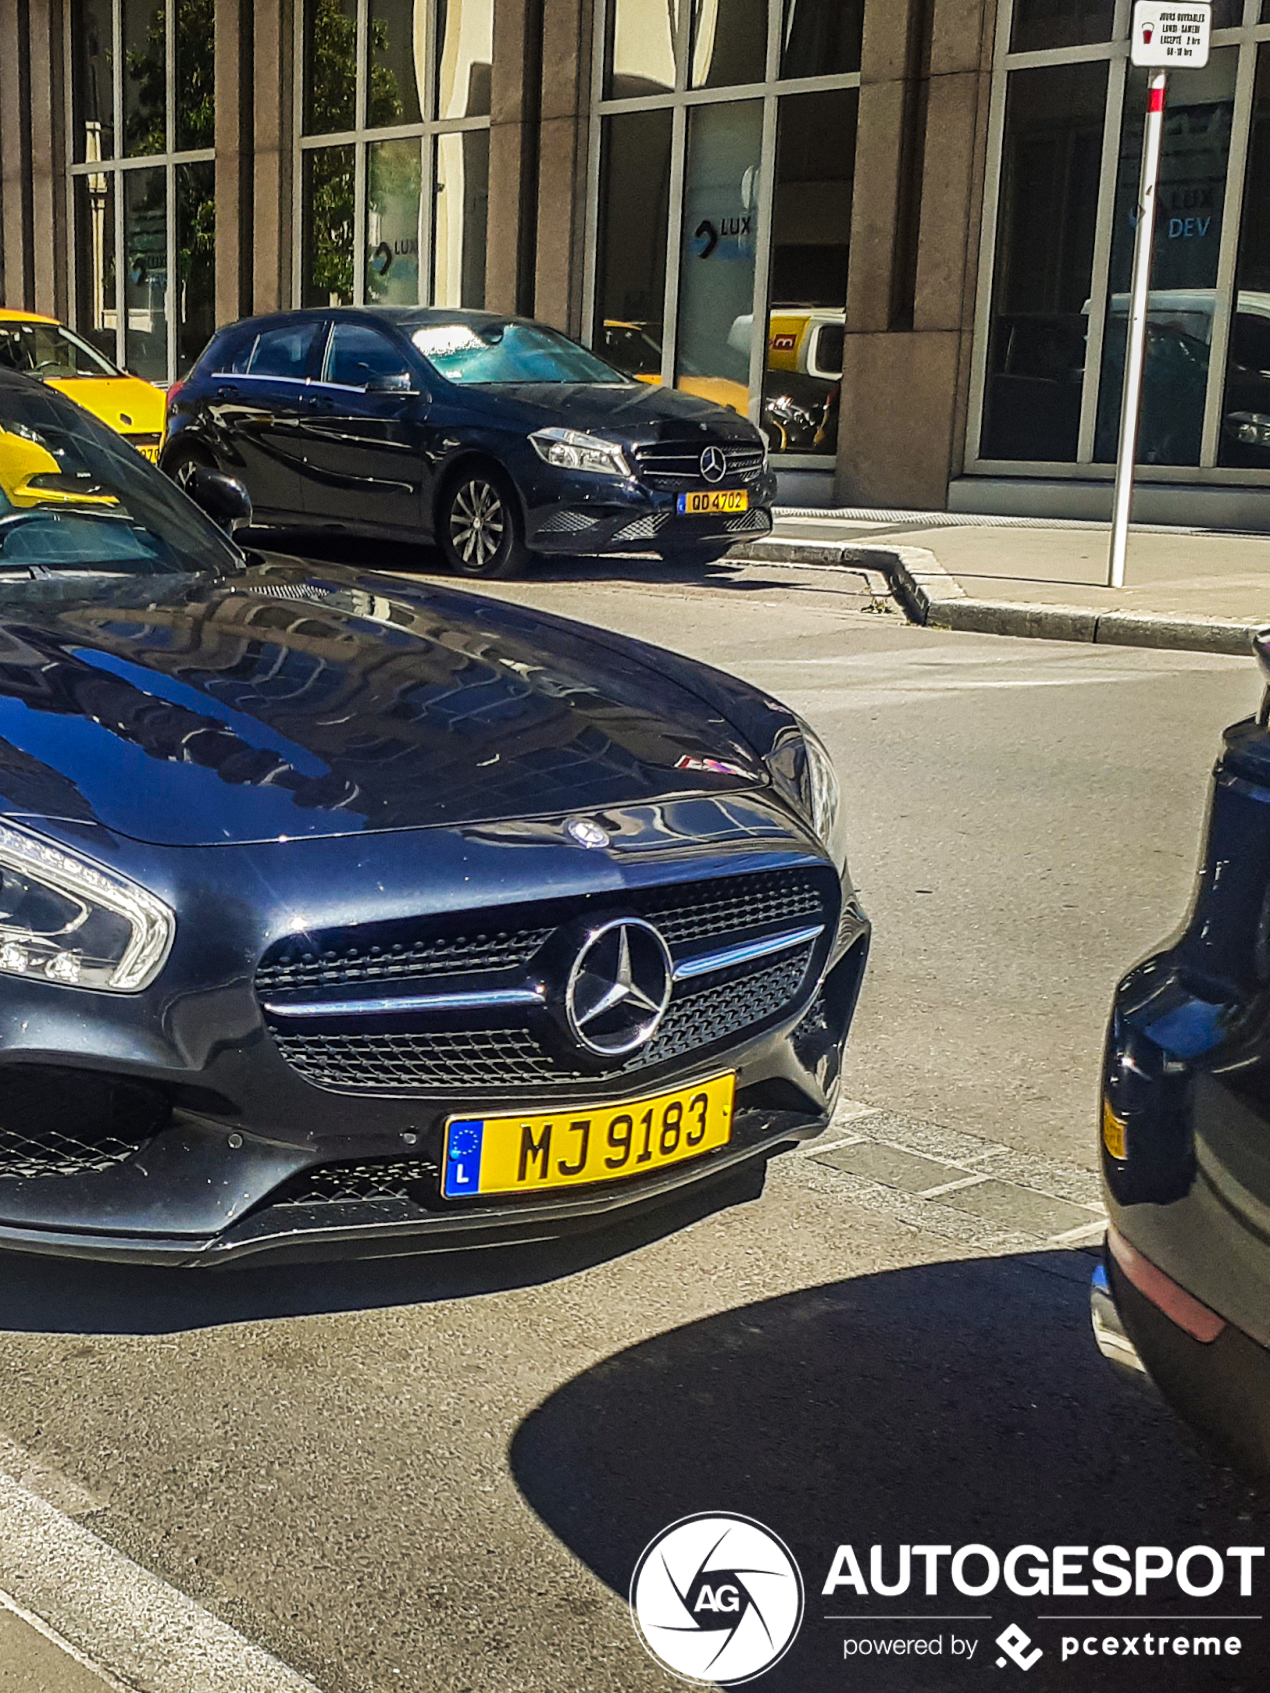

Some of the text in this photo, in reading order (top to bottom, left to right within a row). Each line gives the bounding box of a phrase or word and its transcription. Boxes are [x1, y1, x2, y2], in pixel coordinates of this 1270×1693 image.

[721, 216, 751, 236] LUX
[1168, 215, 1211, 238] DEV
[712, 492, 742, 510] 4702
[517, 1093, 709, 1182] MJ 9183
[456, 1164, 470, 1184] L
